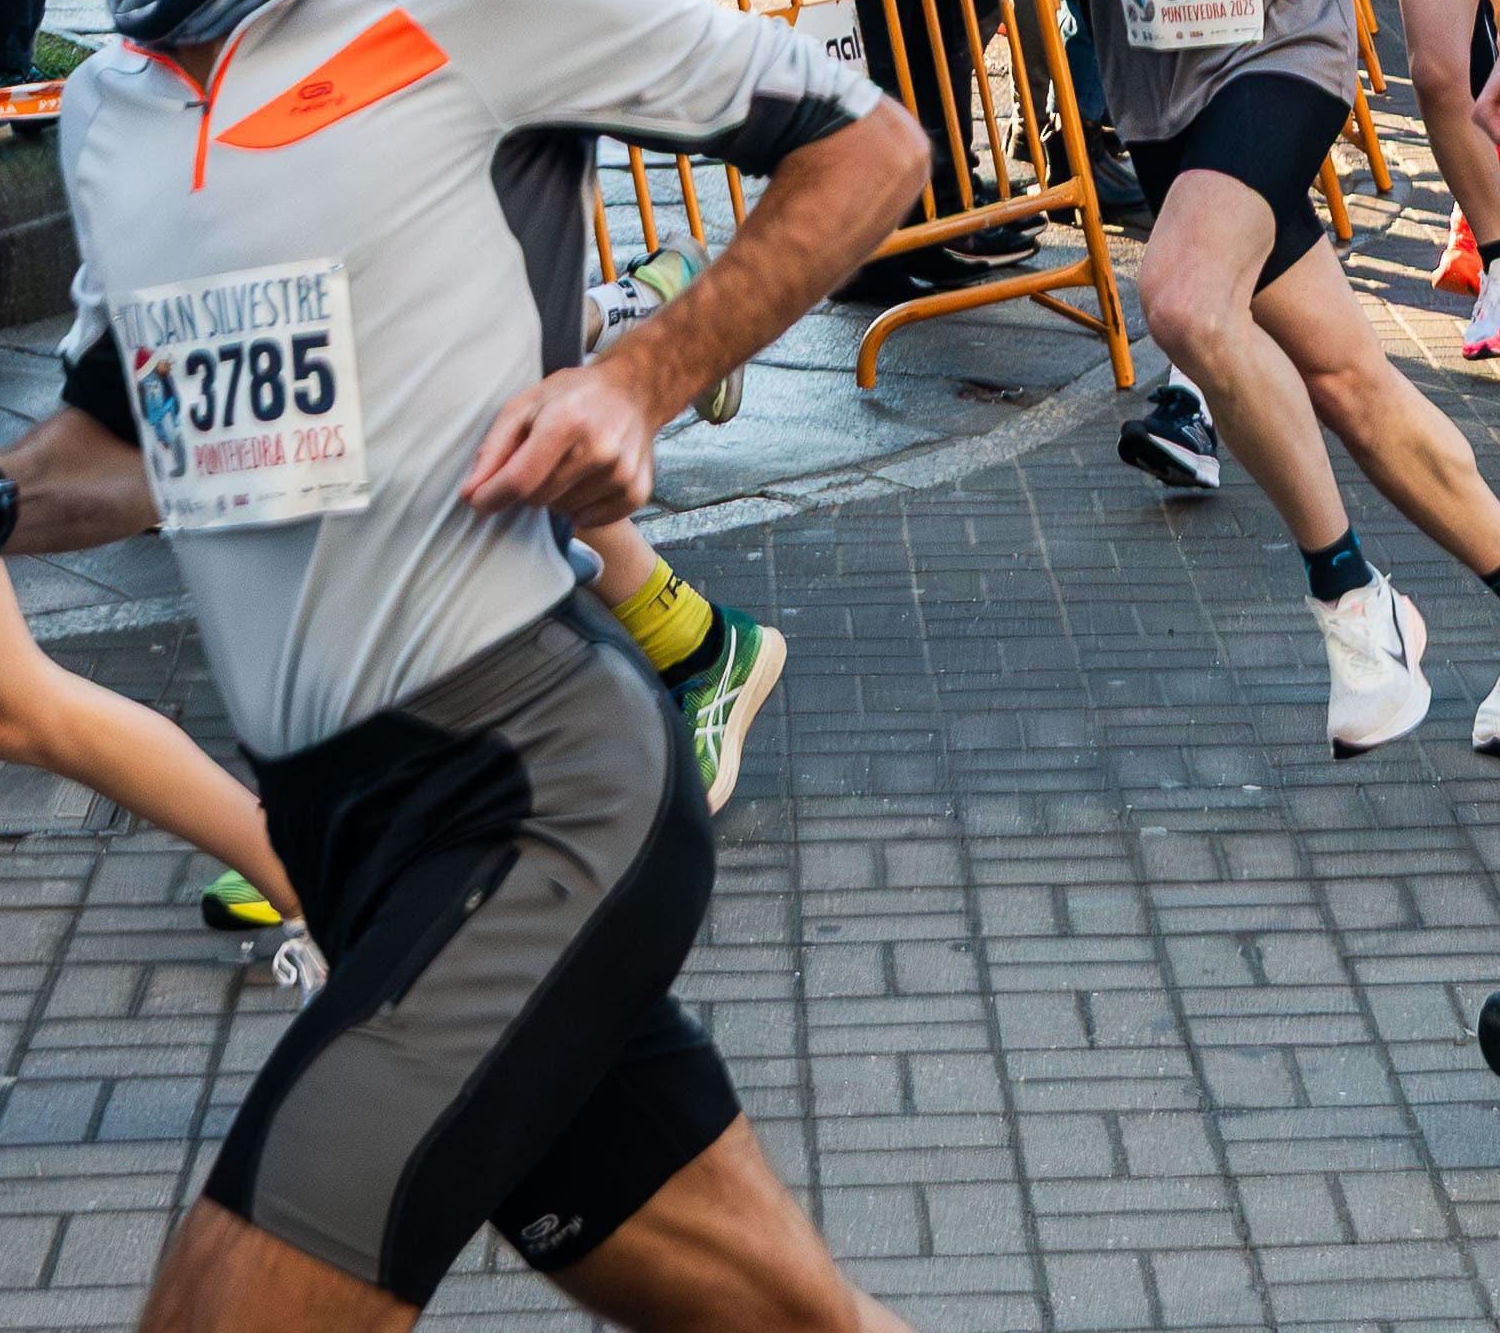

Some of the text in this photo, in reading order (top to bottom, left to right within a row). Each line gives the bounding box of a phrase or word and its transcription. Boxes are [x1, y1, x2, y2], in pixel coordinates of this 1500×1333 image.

[1161, 3, 1227, 24] PONTEVEDRA
[147, 292, 198, 347] SAN
[200, 271, 332, 337] SILVESTRE
[184, 328, 337, 433] 3785
[193, 423, 348, 477] PONTEVEDRA 2025
